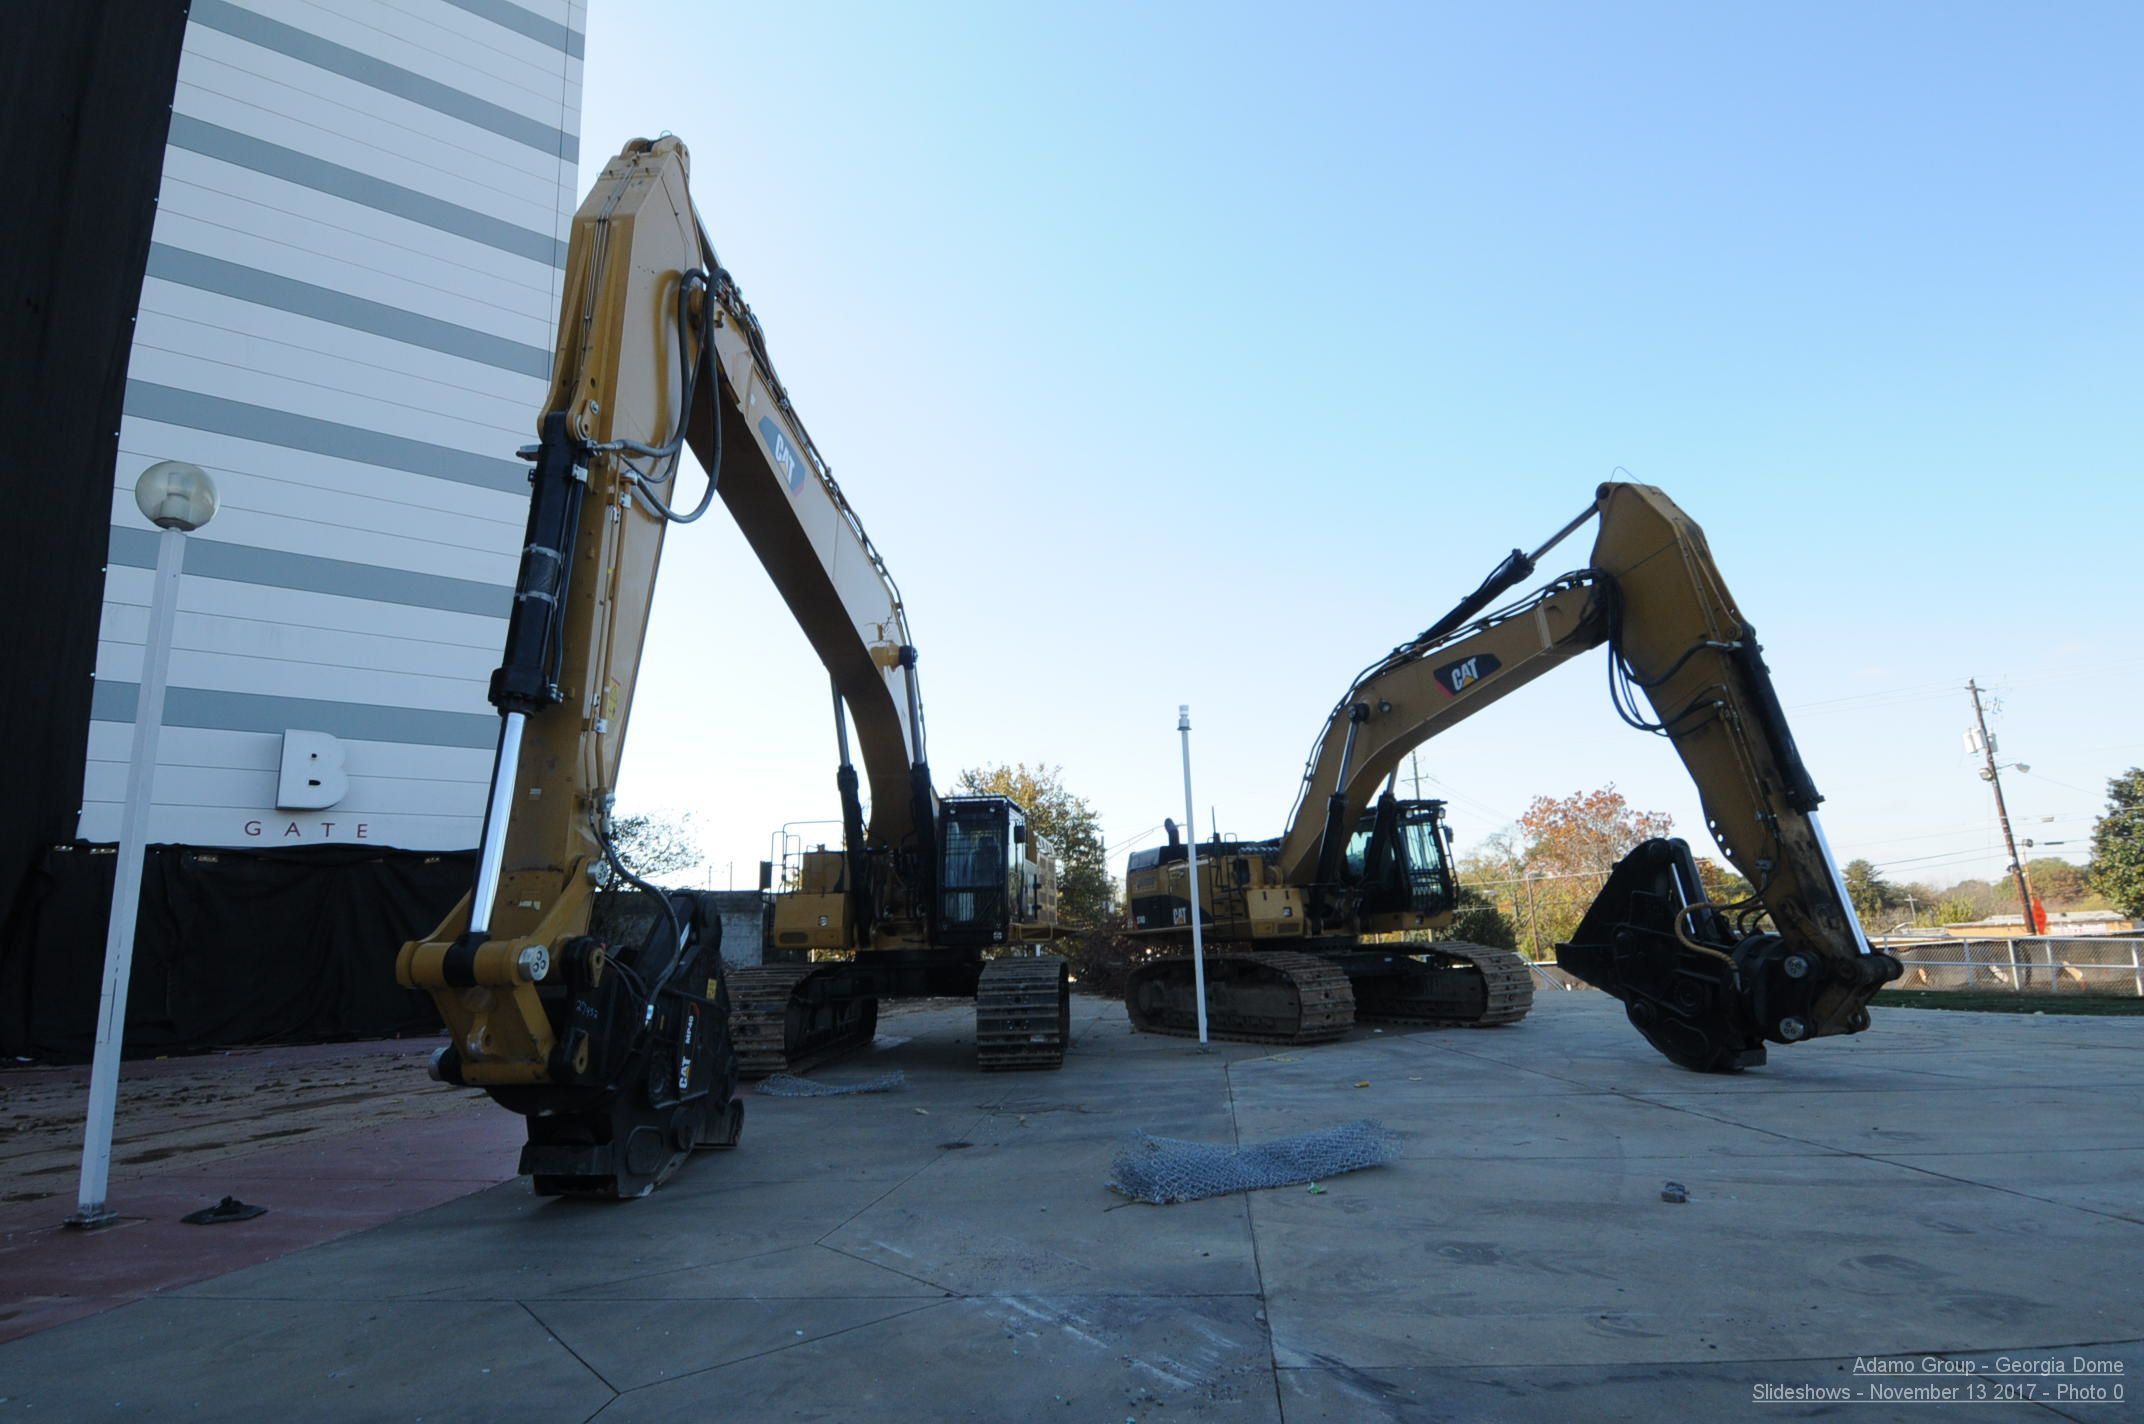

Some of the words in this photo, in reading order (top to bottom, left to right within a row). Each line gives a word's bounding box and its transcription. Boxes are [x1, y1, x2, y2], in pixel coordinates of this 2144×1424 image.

[775, 434, 795, 484] CAT
[1451, 657, 1479, 691] CAT
[276, 729, 350, 811] B
[244, 821, 368, 838] GATE
[1173, 907, 1187, 925] CAT
[679, 1055, 691, 1089] CAT
